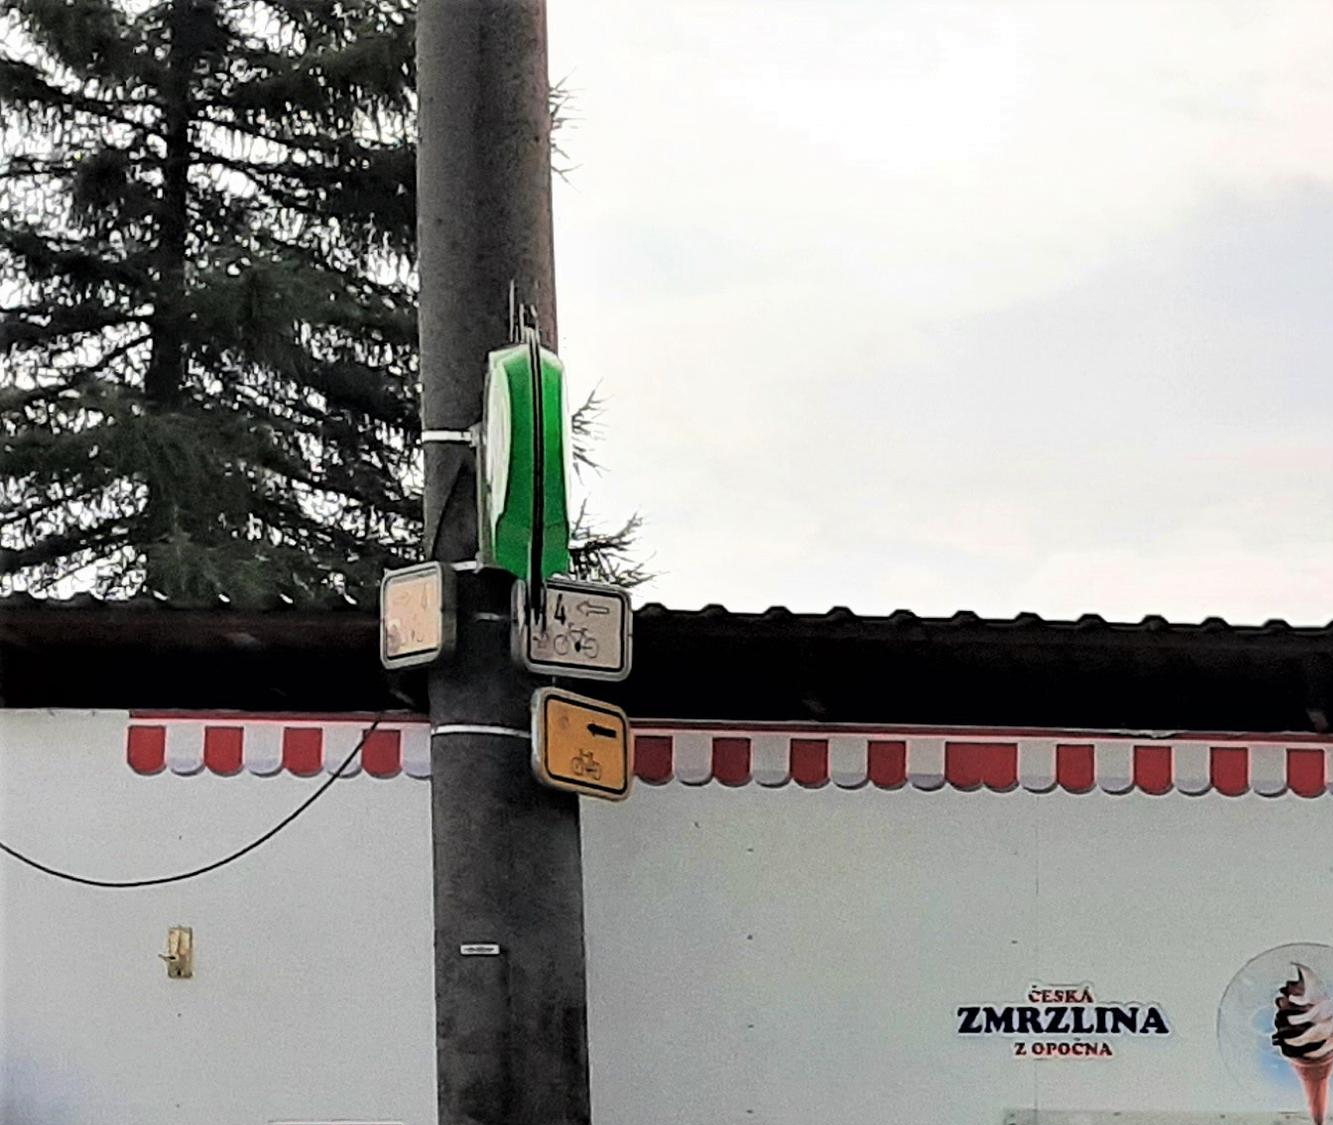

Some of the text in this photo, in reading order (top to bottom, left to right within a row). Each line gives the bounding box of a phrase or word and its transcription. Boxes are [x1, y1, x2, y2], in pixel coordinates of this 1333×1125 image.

[554, 593, 566, 625] 4
[1028, 985, 1093, 1003] ČESKÁ
[957, 1006, 1169, 1034] ZMRZLINA
[1014, 1038, 1112, 1056] Z OPOČNA
